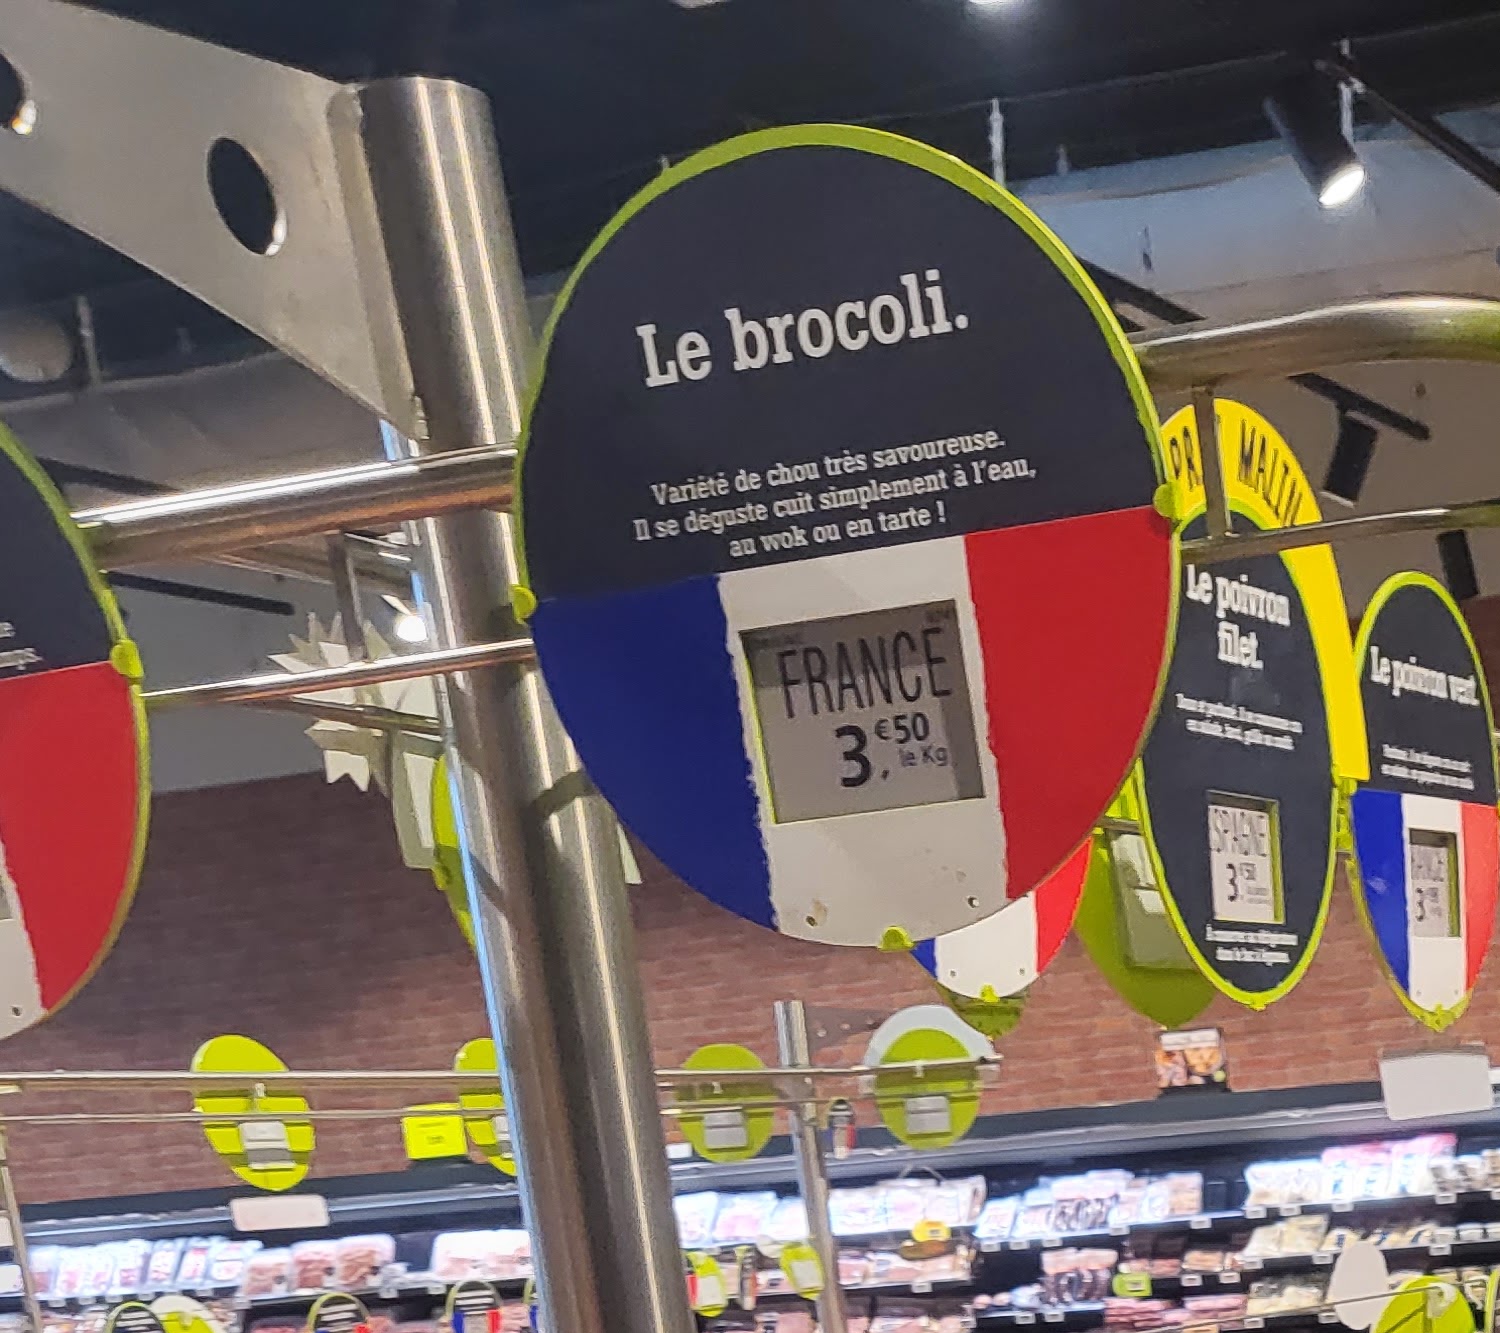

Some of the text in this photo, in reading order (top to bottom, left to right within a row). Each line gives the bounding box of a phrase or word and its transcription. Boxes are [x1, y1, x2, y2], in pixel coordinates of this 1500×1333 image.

[635, 268, 970, 388] Le brocoli.
[632, 518, 652, 541] Il
[654, 518, 681, 539] se
[684, 502, 769, 535] déguste
[772, 491, 816, 518] cuit
[818, 468, 950, 510] simplement
[952, 463, 969, 488] à
[650, 429, 1007, 506] Variété de chou très savoureuse.
[729, 537, 758, 558] au
[759, 525, 810, 553] wok
[812, 523, 842, 544] ou
[845, 517, 875, 538] en
[876, 506, 933, 533] tarte
[1185, 563, 1292, 628] Le poivron
[776, 626, 952, 719] FRANCE
[1370, 645, 1391, 687] Le
[1391, 655, 1449, 697] poivron
